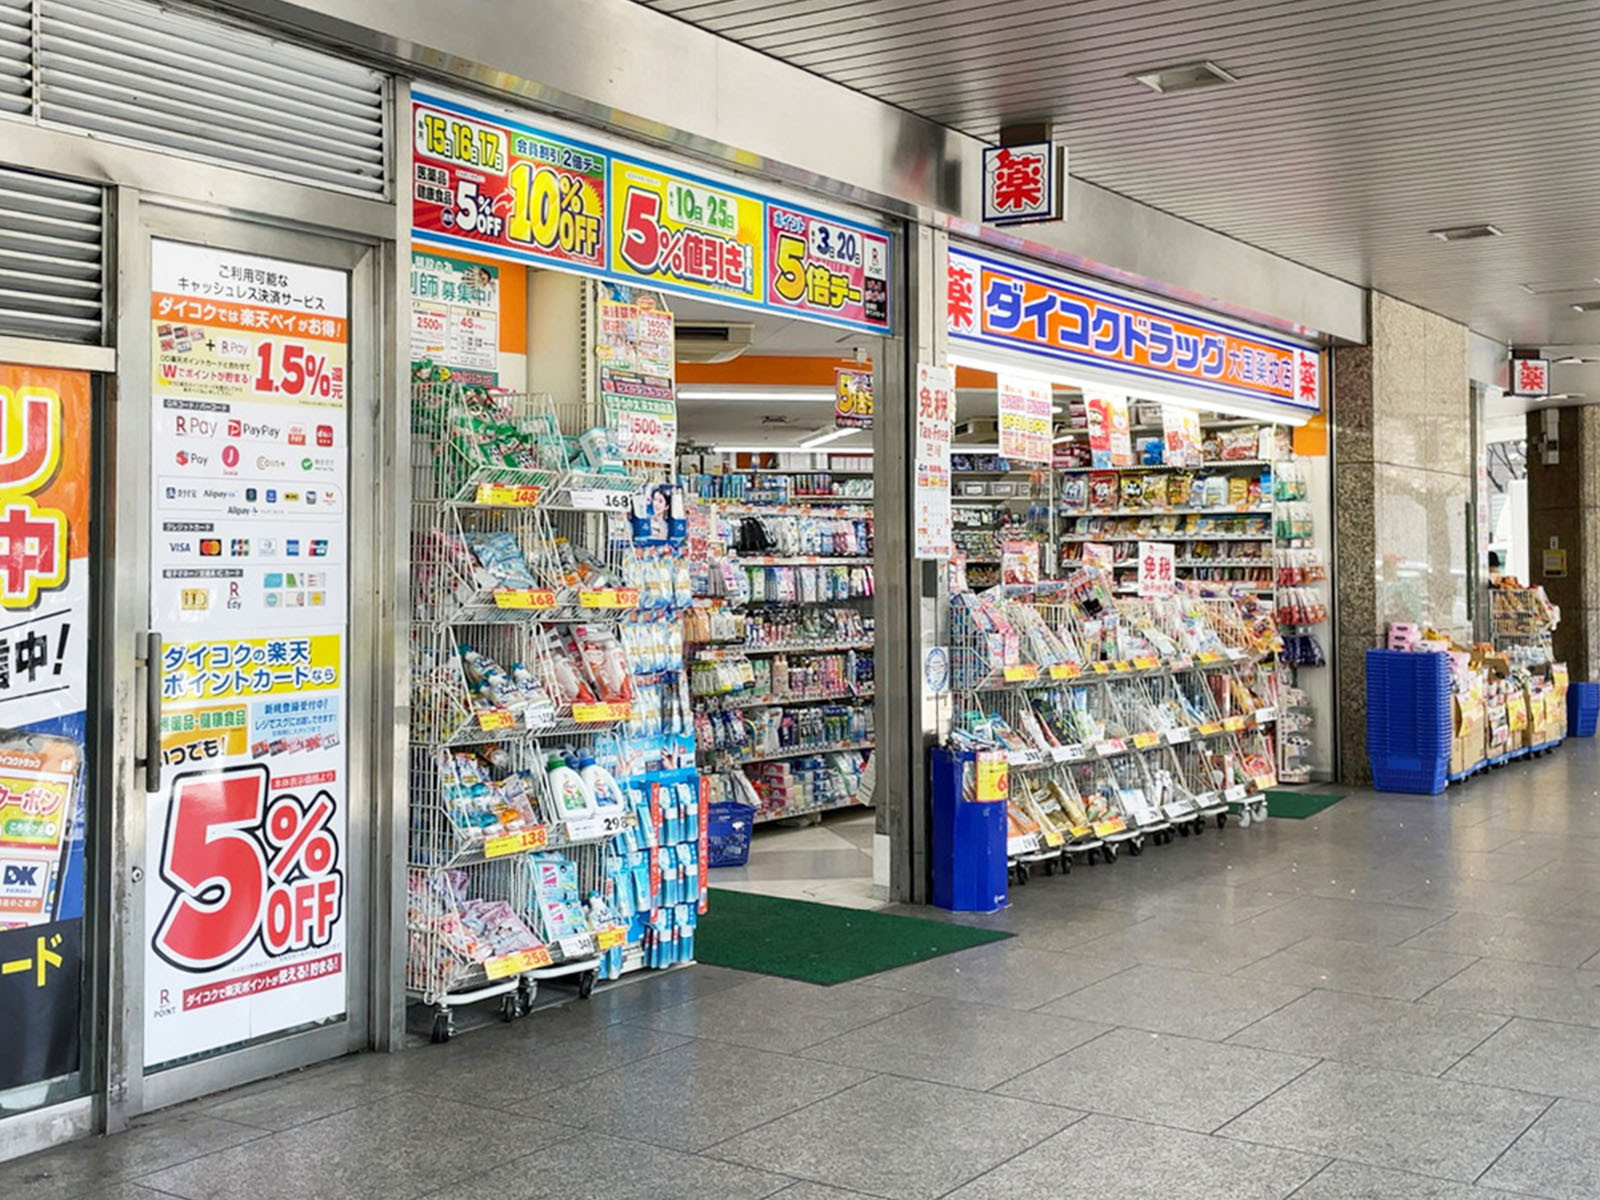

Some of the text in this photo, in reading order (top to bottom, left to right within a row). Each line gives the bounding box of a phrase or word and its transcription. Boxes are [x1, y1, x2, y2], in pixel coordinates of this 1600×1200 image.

[995, 148, 1042, 210] 薬
[219, 264, 289, 287] ご利用可能な
[178, 276, 326, 311] キャッシュレス決済サービス
[986, 281, 1226, 375] ダイコクドラッグ
[243, 422, 280, 440] PayPay
[605, 495, 629, 508] 168
[169, 542, 191, 552] VISA
[529, 594, 554, 606] 168
[164, 642, 310, 669] ダイコクの楽天
[164, 667, 336, 695] ポイントカードなら
[520, 830, 546, 846] 138
